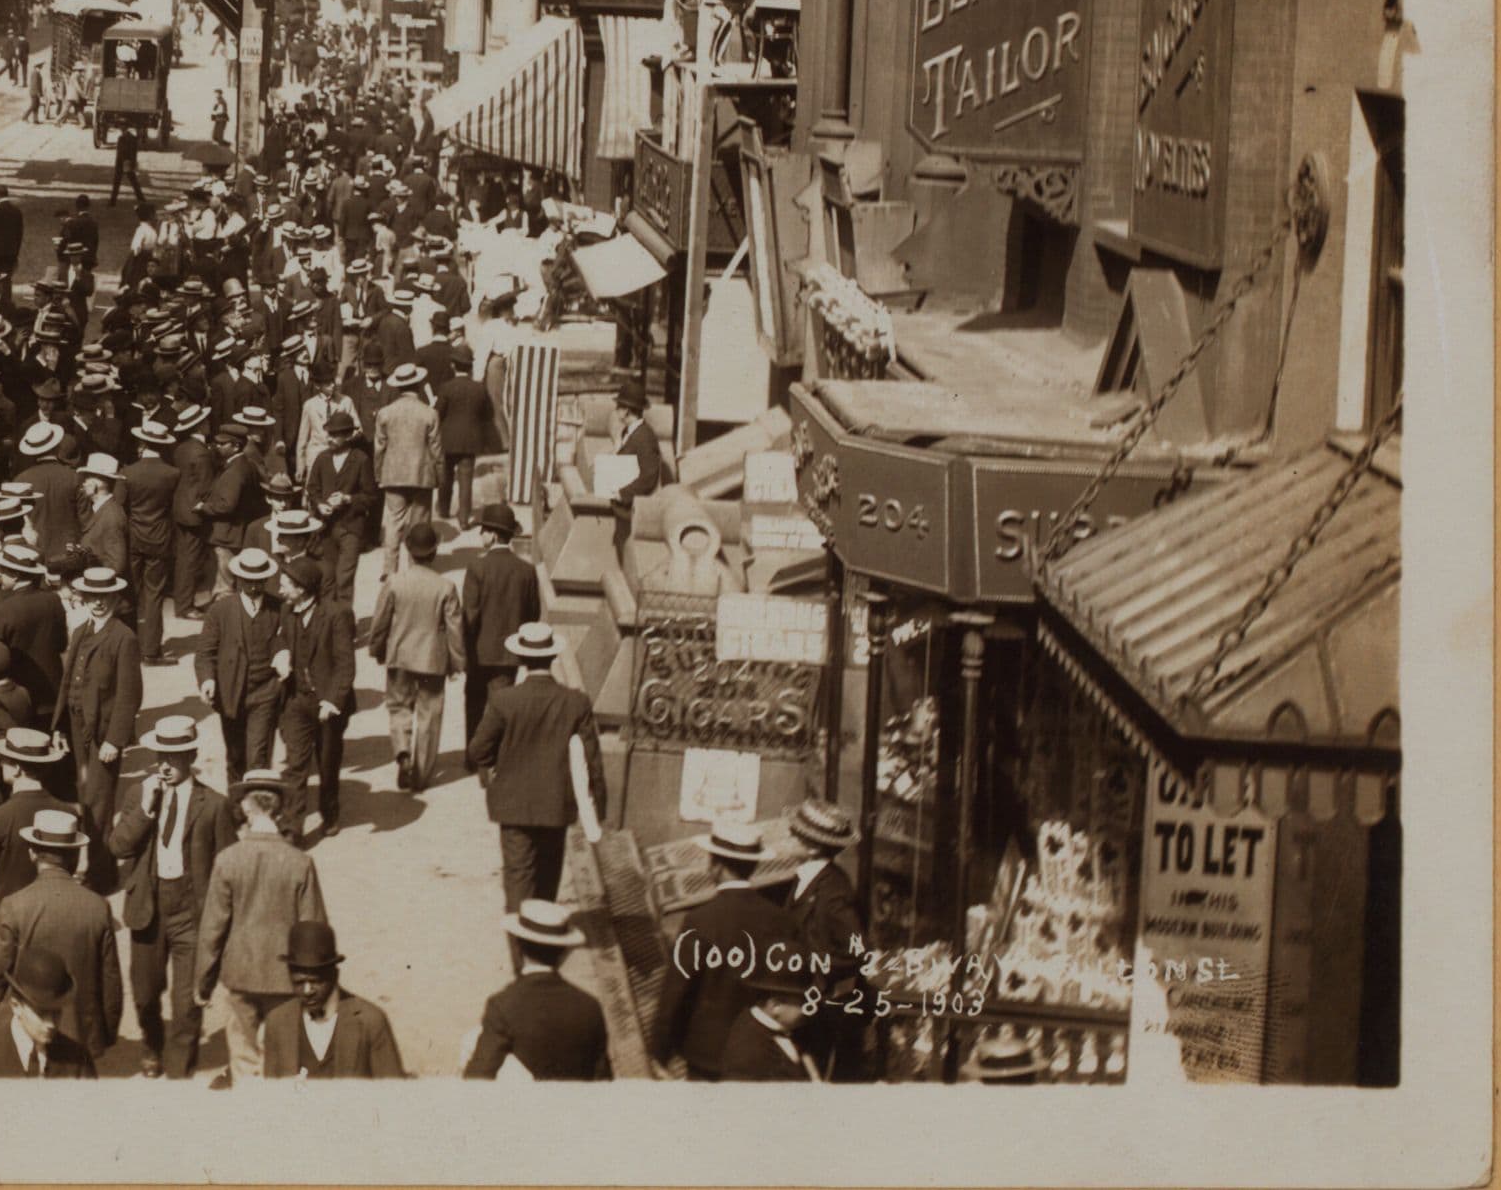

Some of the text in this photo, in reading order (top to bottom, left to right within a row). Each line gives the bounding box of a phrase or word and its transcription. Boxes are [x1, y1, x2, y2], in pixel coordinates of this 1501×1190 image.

[921, 10, 1082, 141] TAILOR
[859, 493, 929, 540] 204
[638, 678, 804, 735] CIGARS
[1154, 820, 1265, 878] TO LET
